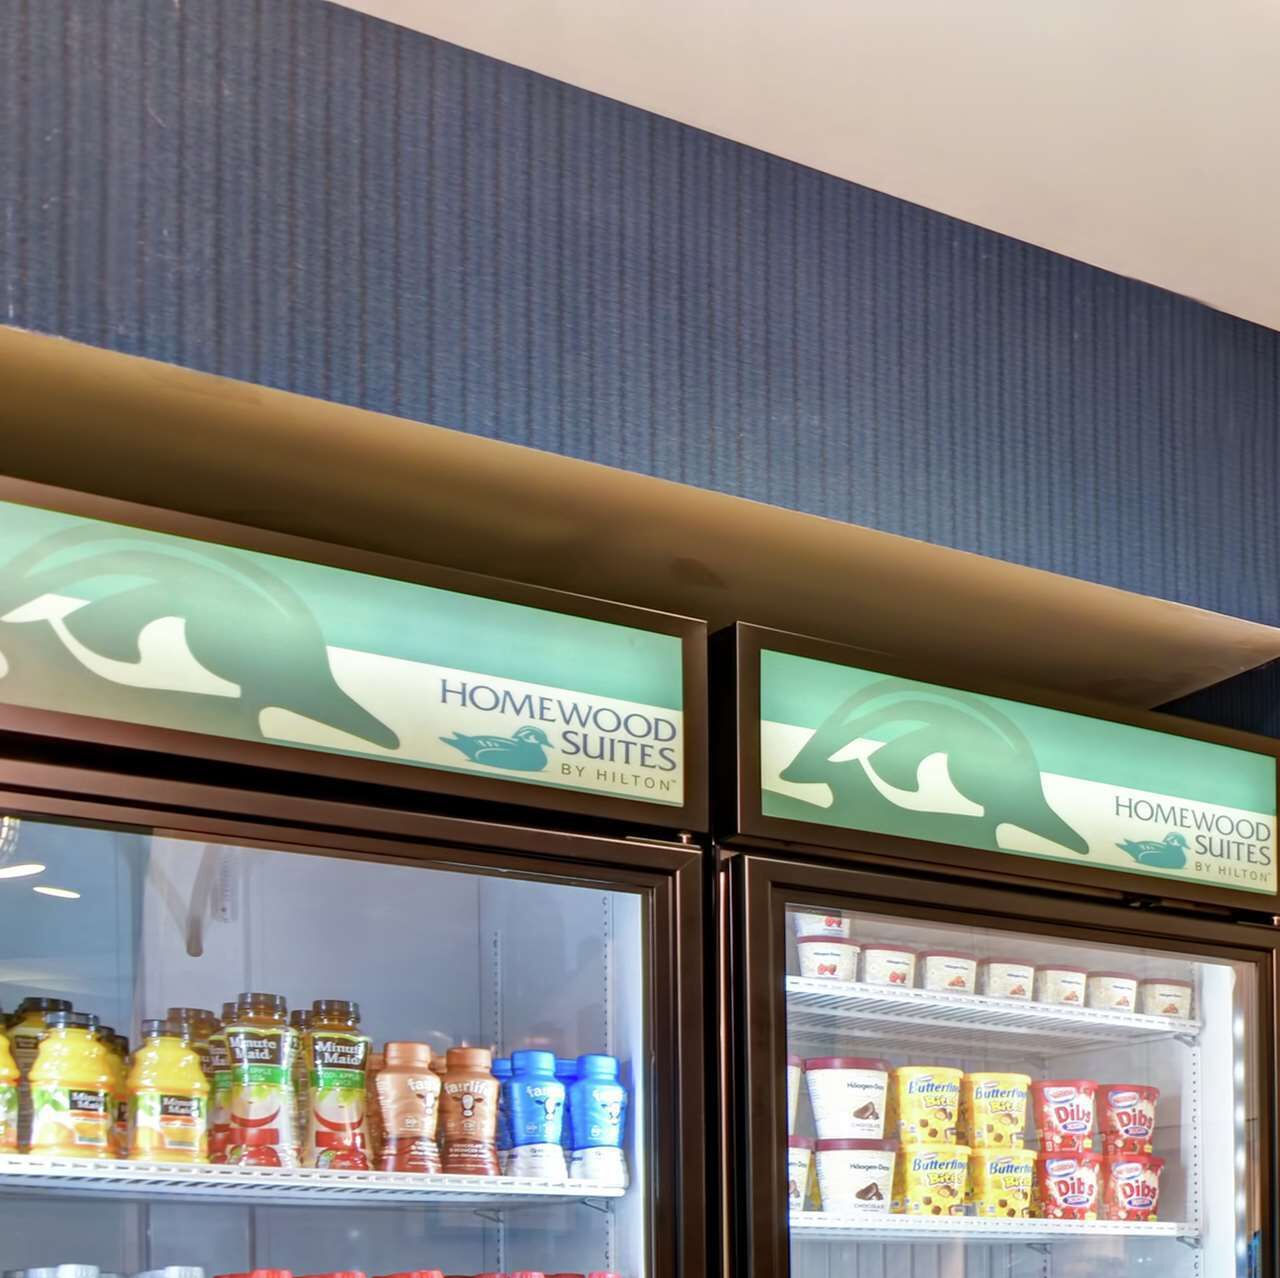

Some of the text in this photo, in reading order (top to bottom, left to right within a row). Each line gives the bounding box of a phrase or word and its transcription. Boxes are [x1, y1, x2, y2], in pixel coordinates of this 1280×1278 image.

[440, 678, 678, 742] HOMEWOOD
[560, 730, 678, 772] SUITES
[560, 763, 587, 778] BY
[1115, 795, 1271, 842] HOMEWOOD
[1194, 835, 1272, 866] SUITES
[1194, 861, 1206, 871] BY
[228, 1035, 278, 1051] Minute
[235, 1048, 273, 1061] Maid
[323, 1052, 363, 1065] Maid
[1054, 1104, 1092, 1124] Dibs
[1116, 1108, 1153, 1130] Dibs
[1056, 1177, 1095, 1198] Dibs
[1121, 1180, 1157, 1199] Dibs
